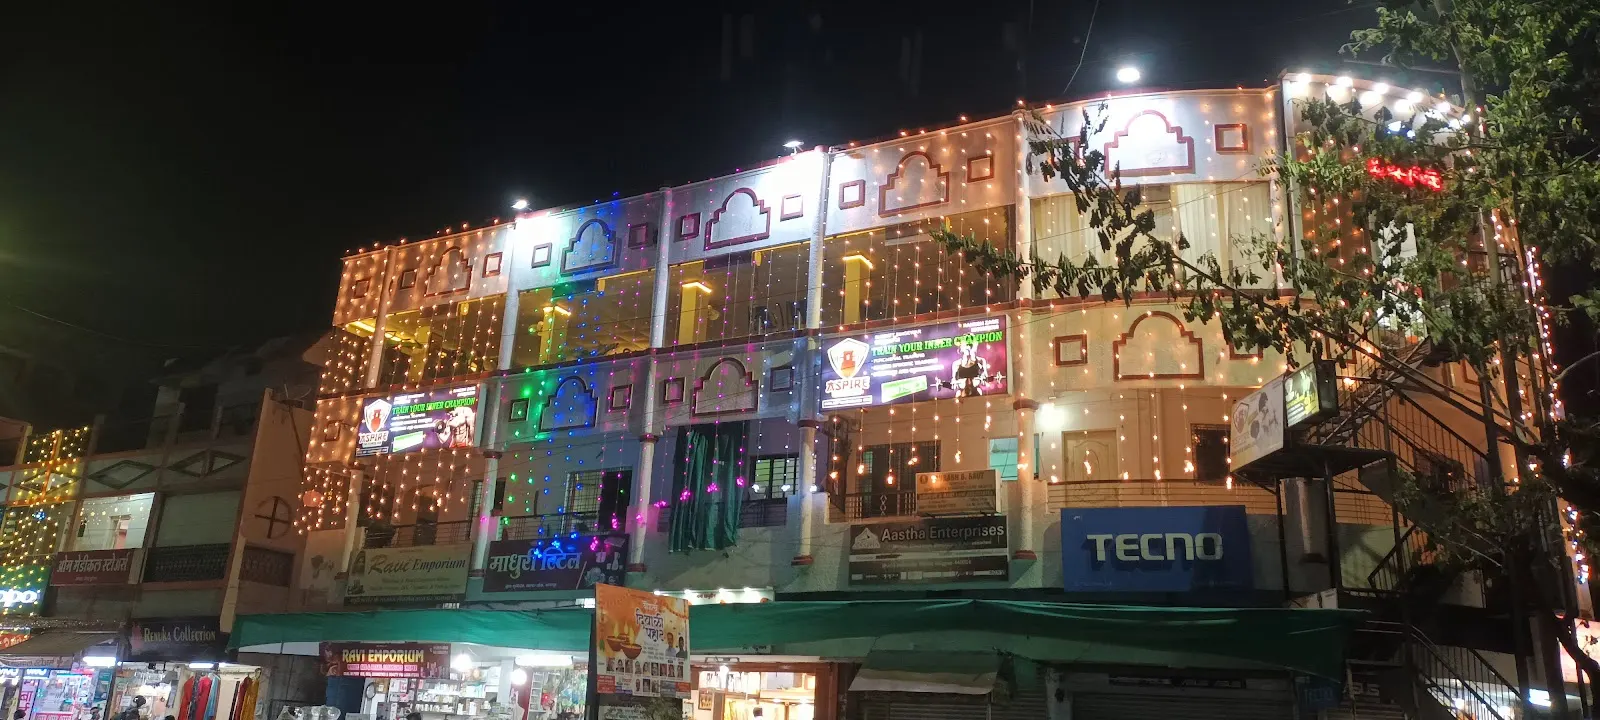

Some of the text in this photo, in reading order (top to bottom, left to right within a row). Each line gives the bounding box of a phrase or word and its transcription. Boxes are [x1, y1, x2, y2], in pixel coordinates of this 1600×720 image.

[872, 331, 1003, 357] TRAIN YOUR INNER CHAMPION
[826, 378, 868, 391] ASPIRE
[392, 406, 409, 415] TRAIN
[410, 404, 425, 413] YOUR
[445, 397, 476, 409] CHAMPION
[360, 432, 388, 443] ASPIRE
[881, 525, 1005, 542] Aastha Enterprises
[1086, 532, 1224, 562] TECNO
[367, 554, 466, 576] Ravi Emporium
[489, 547, 536, 579] माधुरी
[342, 649, 366, 663] RAVI
[368, 649, 425, 665] EMPORIUM
